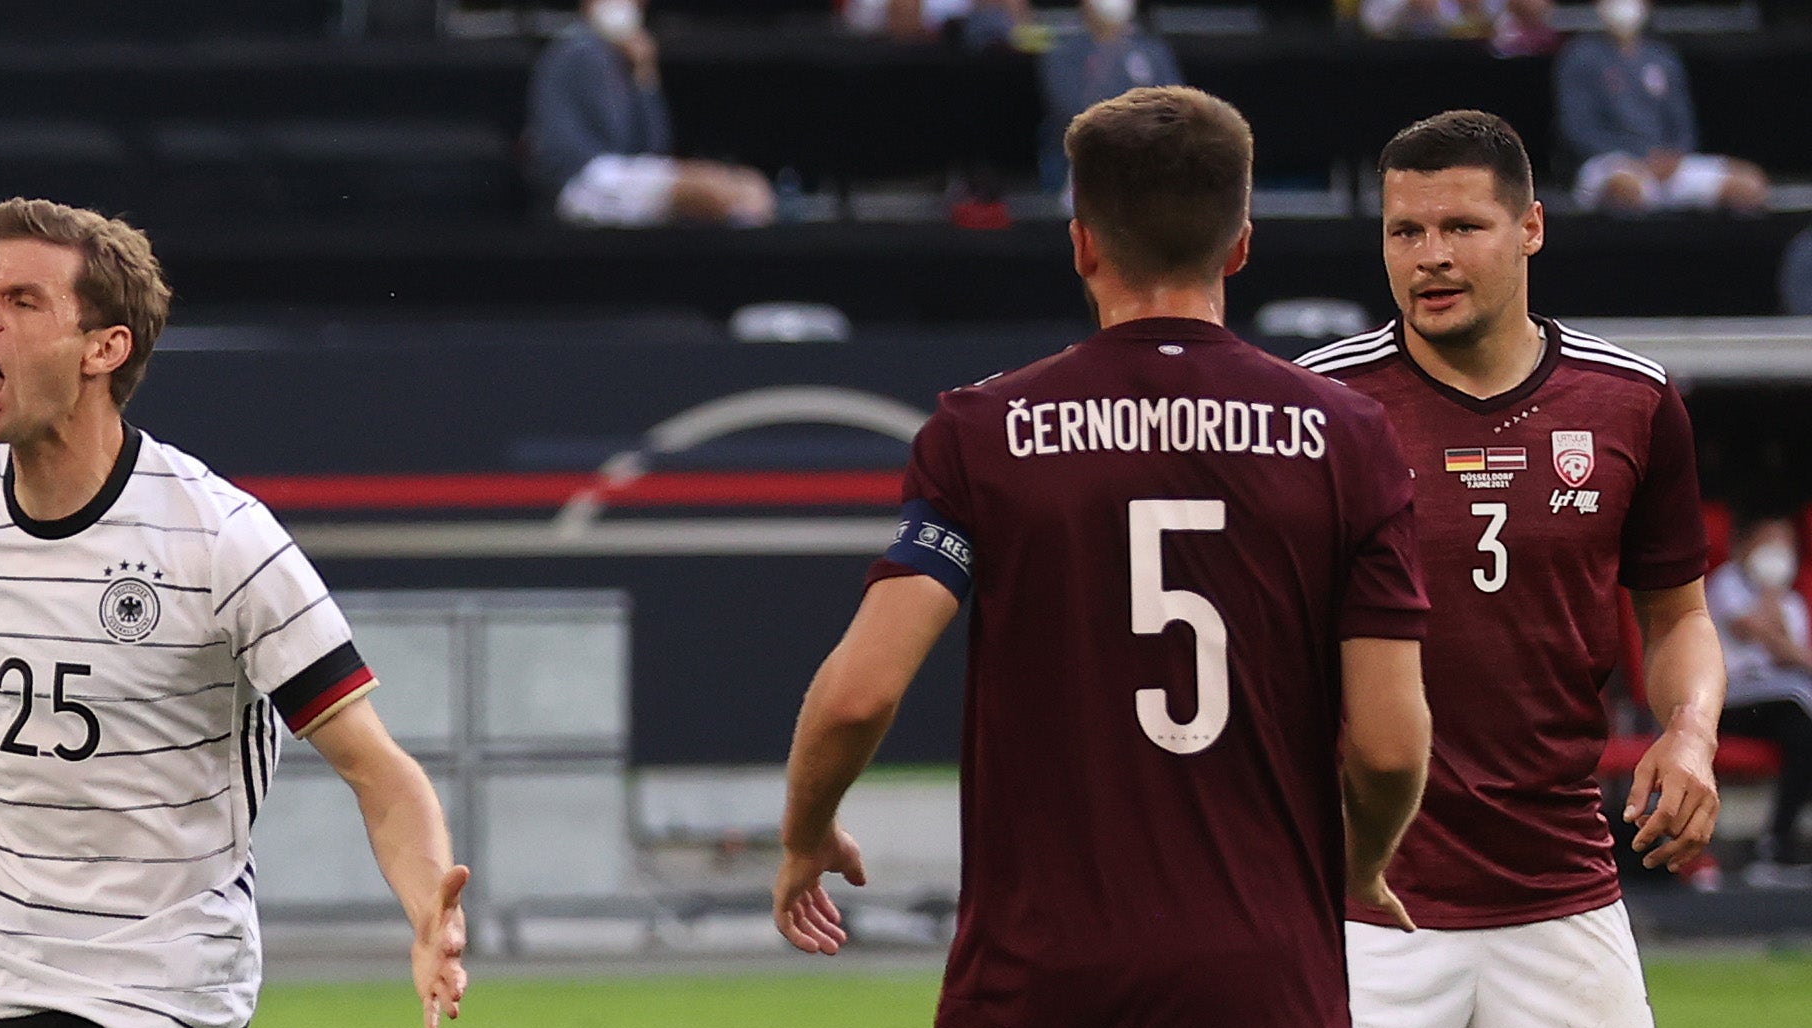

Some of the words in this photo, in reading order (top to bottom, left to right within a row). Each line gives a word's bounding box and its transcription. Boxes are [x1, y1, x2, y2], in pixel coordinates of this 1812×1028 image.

[1006, 398, 1326, 458] ČERNOMORDIJS
[1471, 503, 1509, 593] 3
[1128, 500, 1230, 754] 5
